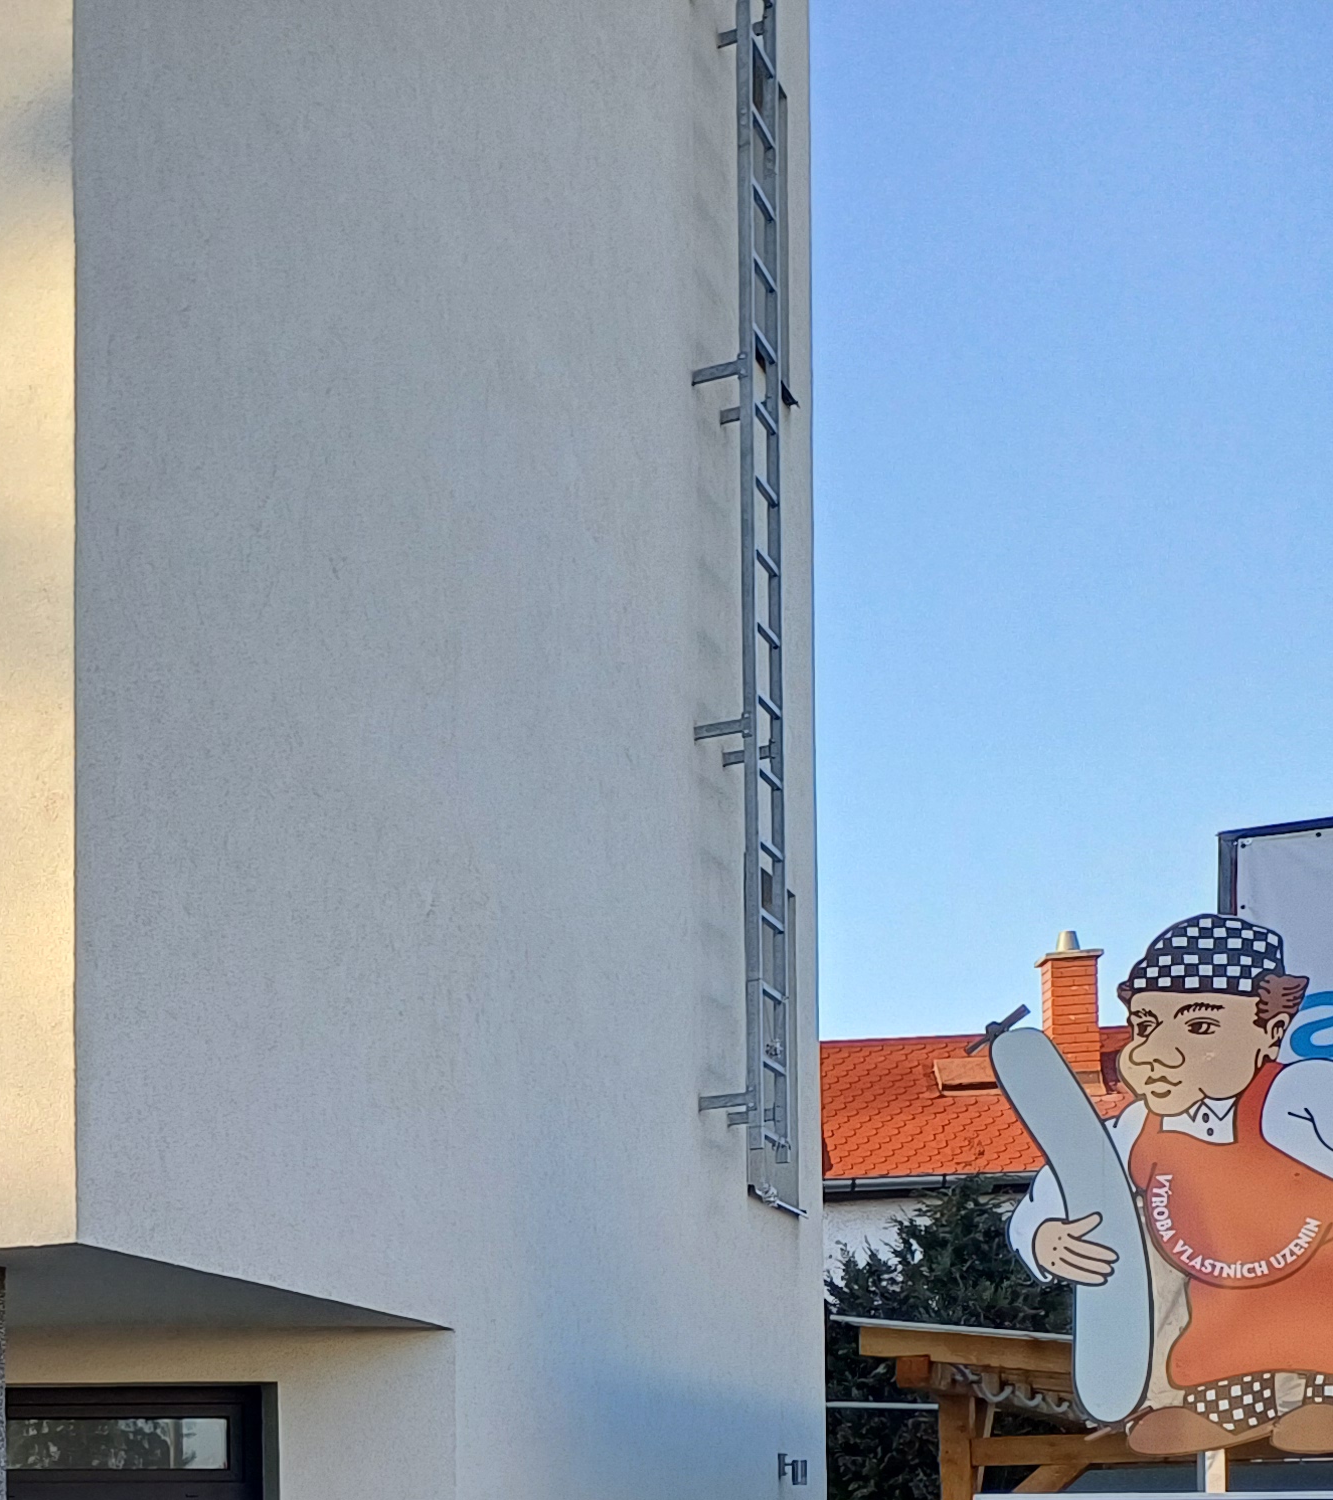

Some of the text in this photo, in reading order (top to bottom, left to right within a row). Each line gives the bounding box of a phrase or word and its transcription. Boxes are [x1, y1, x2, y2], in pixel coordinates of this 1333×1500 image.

[1151, 1174, 1322, 1278] VÝROBA VLASTNÍCH UZENIN
